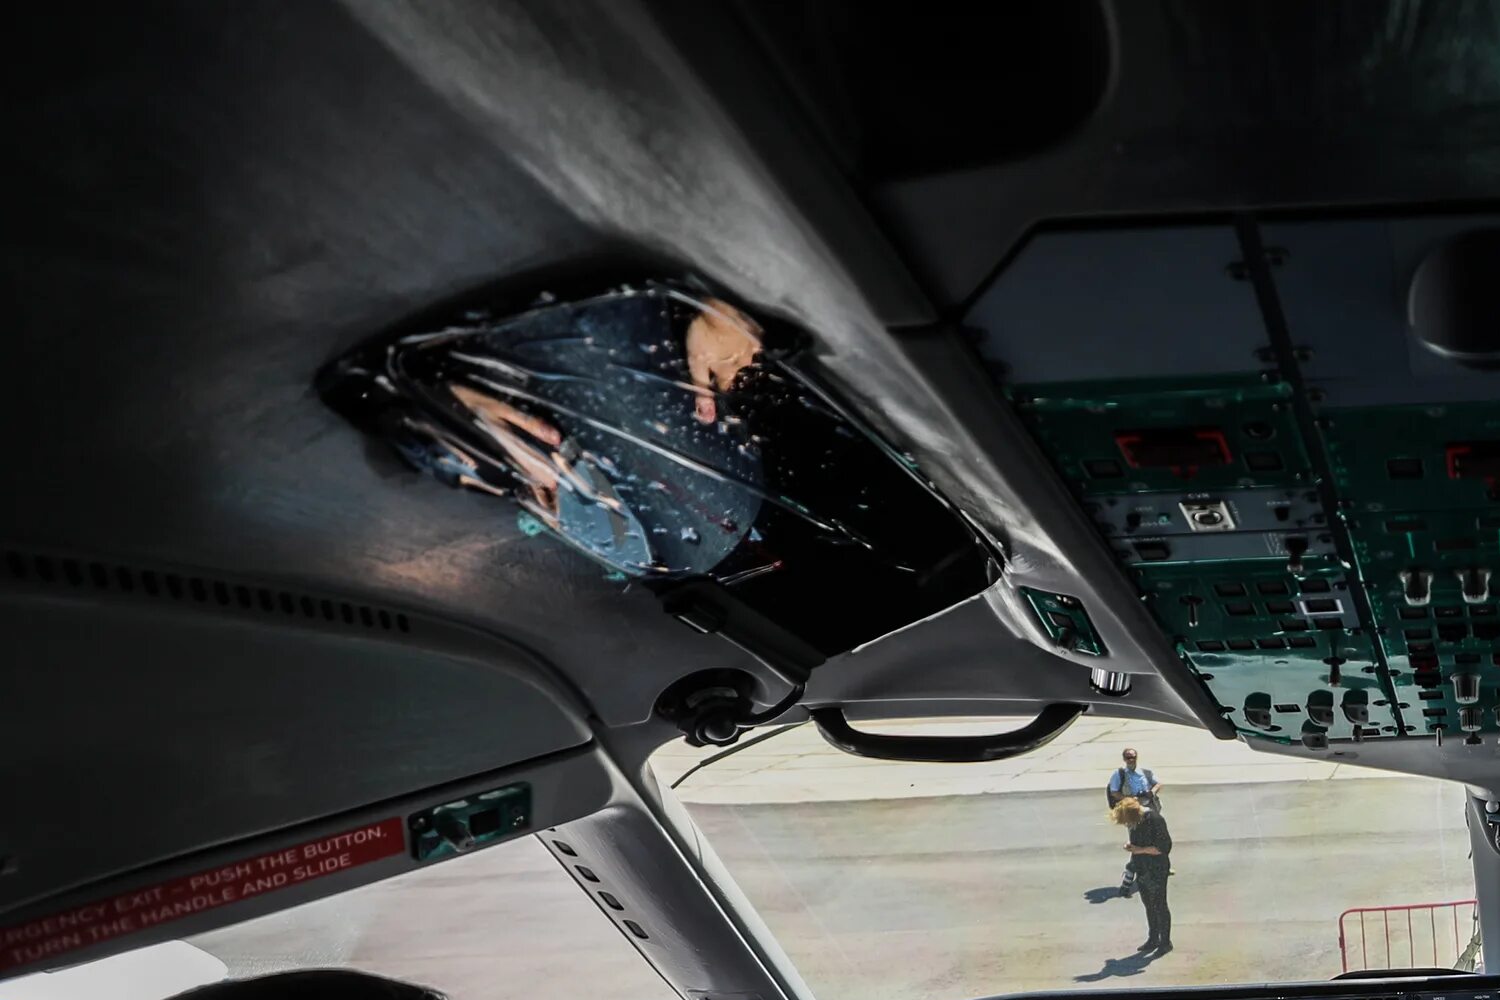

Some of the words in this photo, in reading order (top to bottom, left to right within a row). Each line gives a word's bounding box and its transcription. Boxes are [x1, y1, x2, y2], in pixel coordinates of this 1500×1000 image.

[11, 931, 83, 964] TURN
[89, 914, 134, 942] THE
[140, 885, 237, 927] HANDLE
[242, 872, 288, 898] AND
[292, 852, 353, 882] SLIDE
[115, 884, 162, 913] EXIT
[190, 861, 252, 892] PUSH
[256, 848, 299, 874] THE
